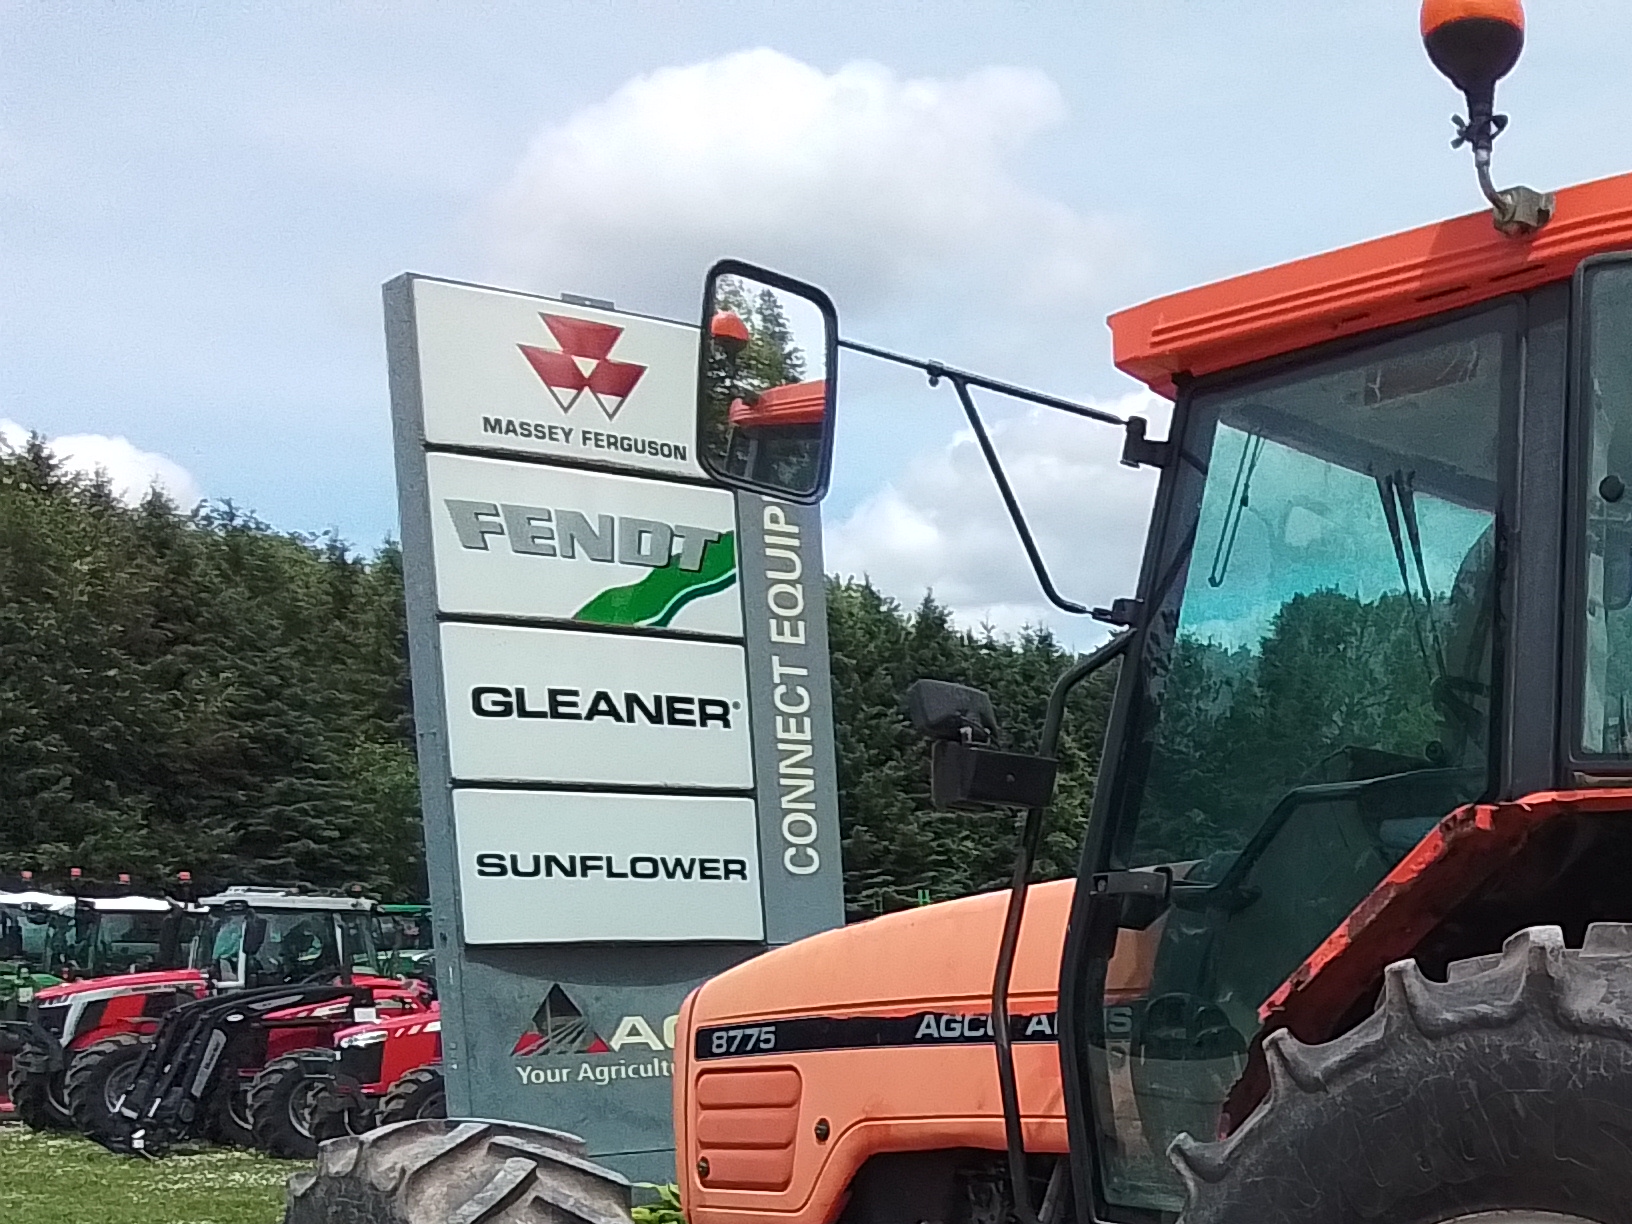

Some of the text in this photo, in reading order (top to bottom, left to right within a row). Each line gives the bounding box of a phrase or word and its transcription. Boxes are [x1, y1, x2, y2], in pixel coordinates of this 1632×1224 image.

[482, 416, 688, 461] MASSEY FERGUSON
[444, 498, 721, 573] FENDT
[763, 496, 820, 875] CONNECT EQUIP
[476, 853, 748, 882] SUNFLOWER
[609, 1014, 679, 1052] A
[711, 1026, 777, 1054] 8775
[914, 1013, 996, 1039] AGC
[516, 1058, 675, 1086] Your Agricult
